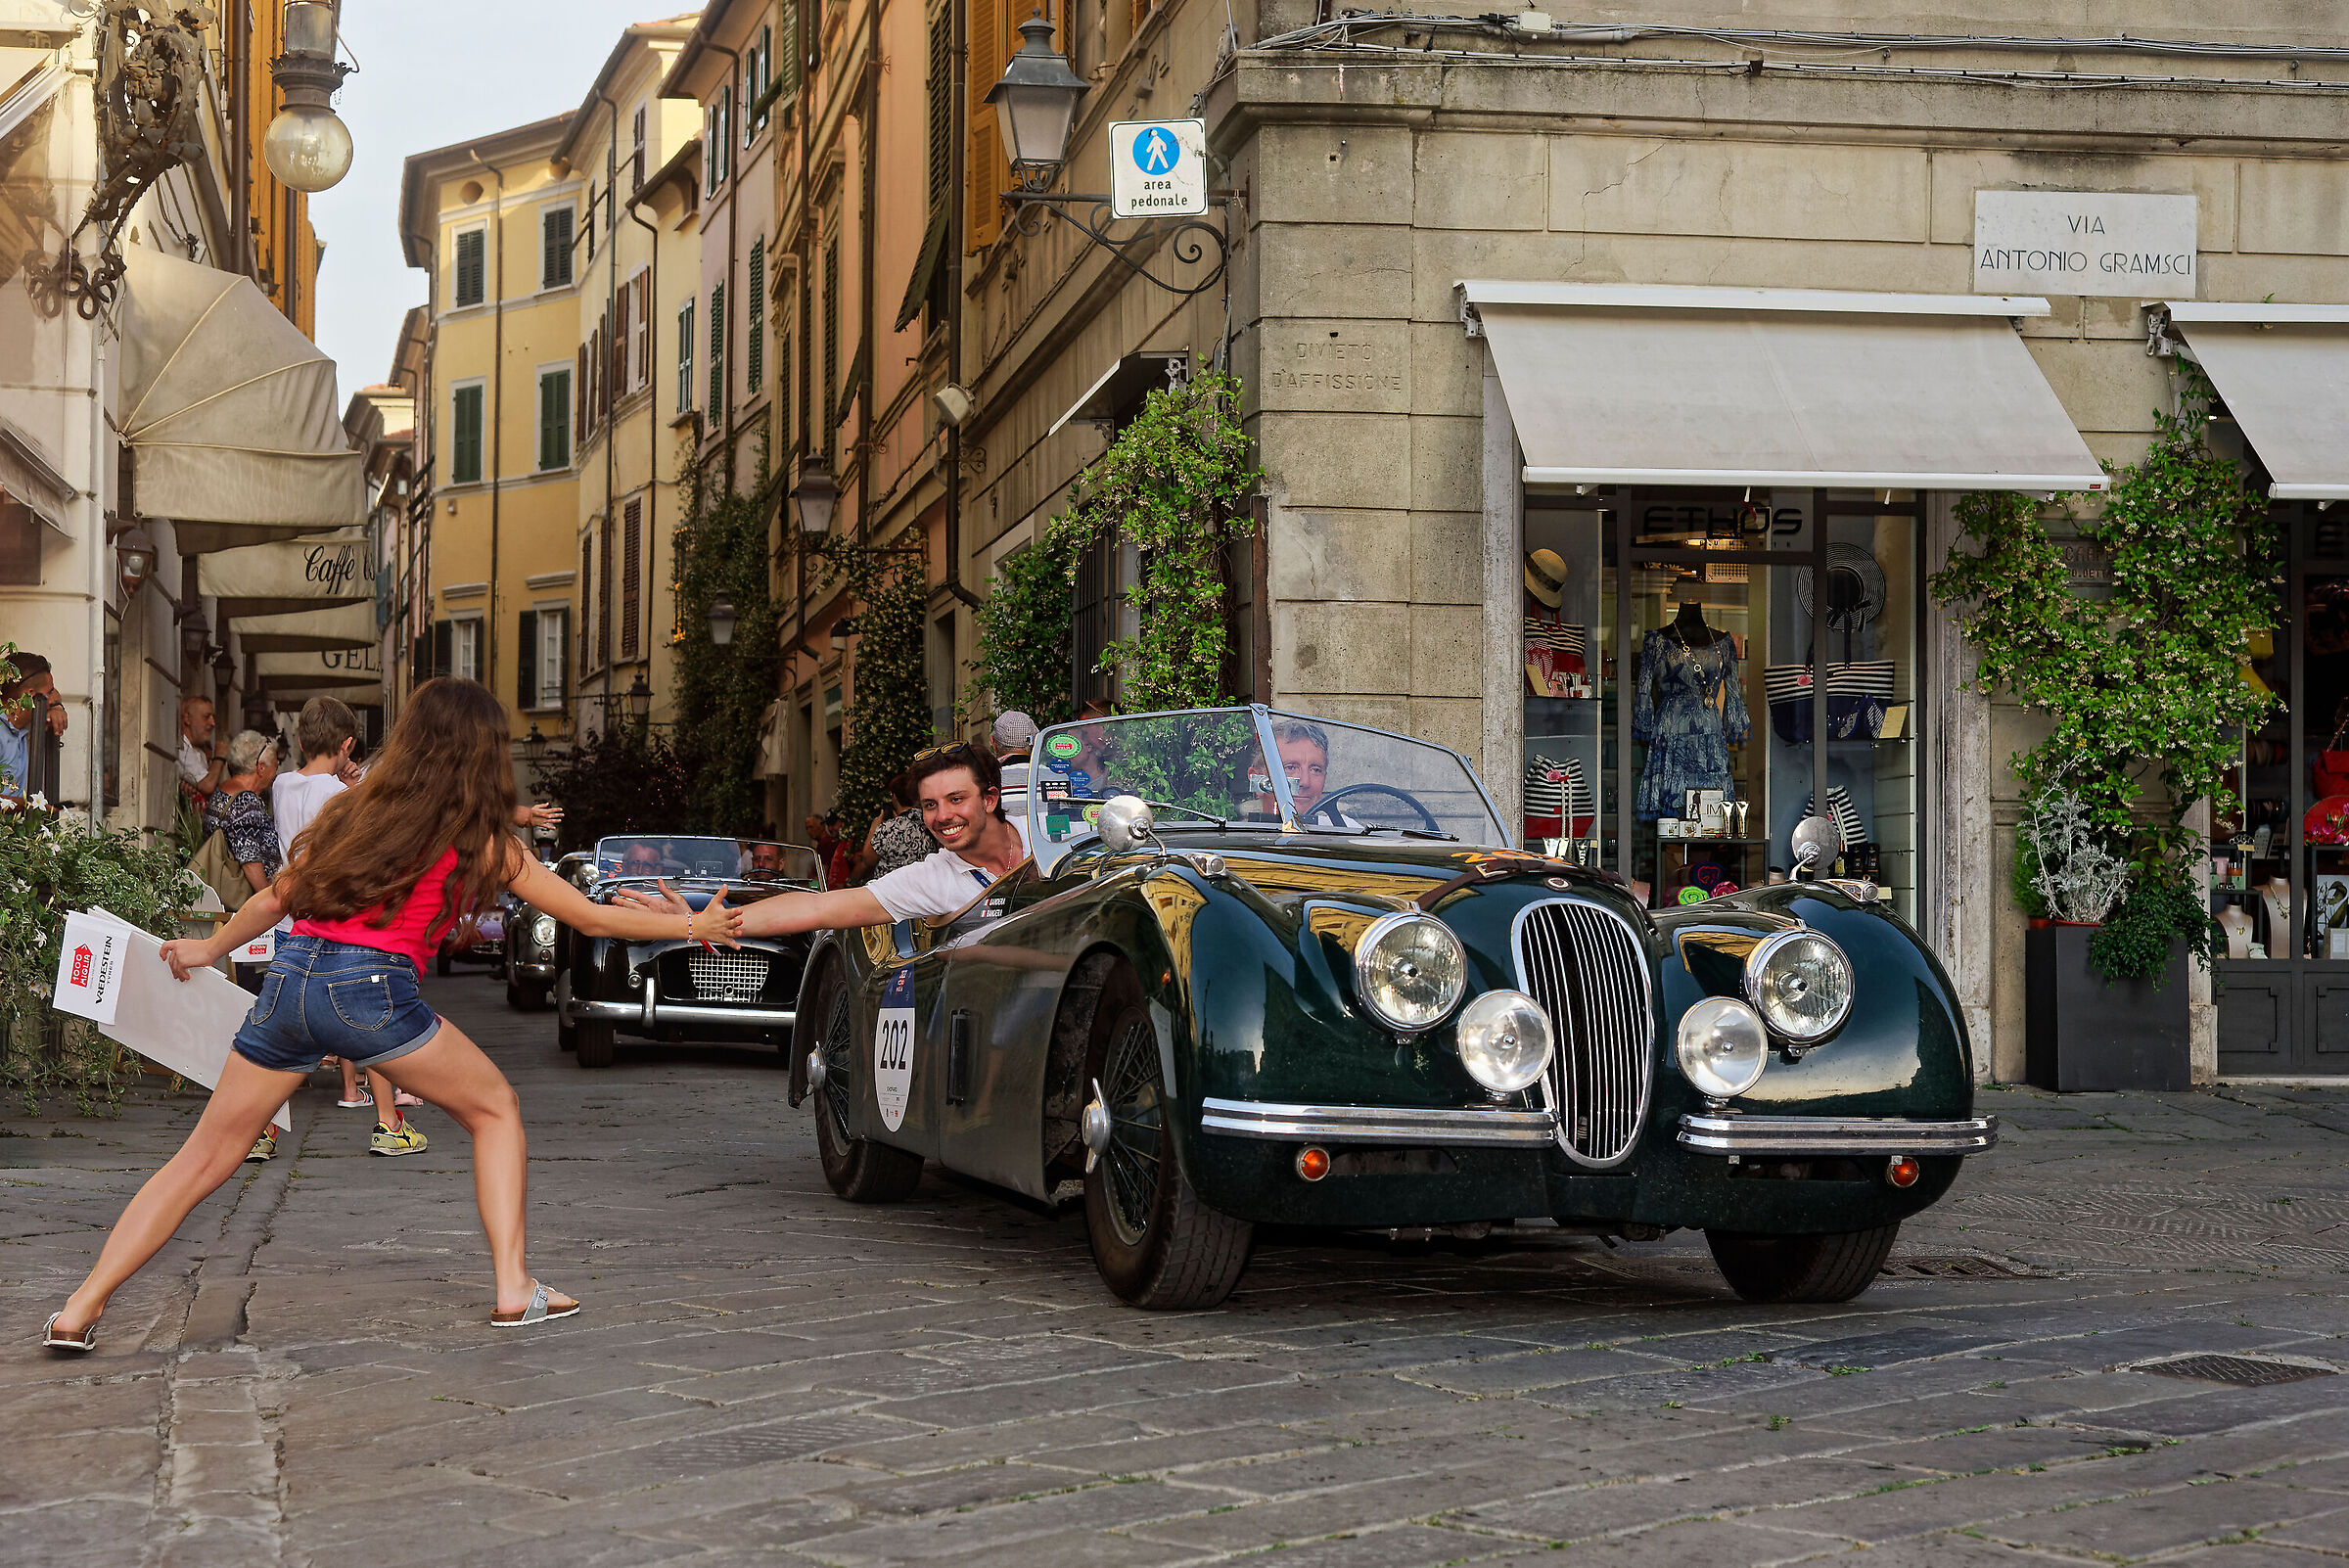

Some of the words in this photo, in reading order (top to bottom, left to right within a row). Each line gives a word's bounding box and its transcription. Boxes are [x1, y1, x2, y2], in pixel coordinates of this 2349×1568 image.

[1143, 180, 1172, 190] area
[1130, 193, 1188, 210] pedonale
[2067, 214, 2105, 235] VIA
[1980, 249, 2088, 272] ANTONIO
[2099, 252, 2190, 275] GRAMSCI
[1297, 343, 1371, 361] DIVIETO
[1272, 368, 1402, 391] D'AFFISSIONE
[1643, 505, 1803, 535] ETHOS
[303, 544, 355, 595] Caffè
[72, 953, 83, 982] 1000
[80, 954, 91, 986] MIGLIA
[95, 935, 114, 1005] VREDESTEIN
[880, 1019, 908, 1070] 202
